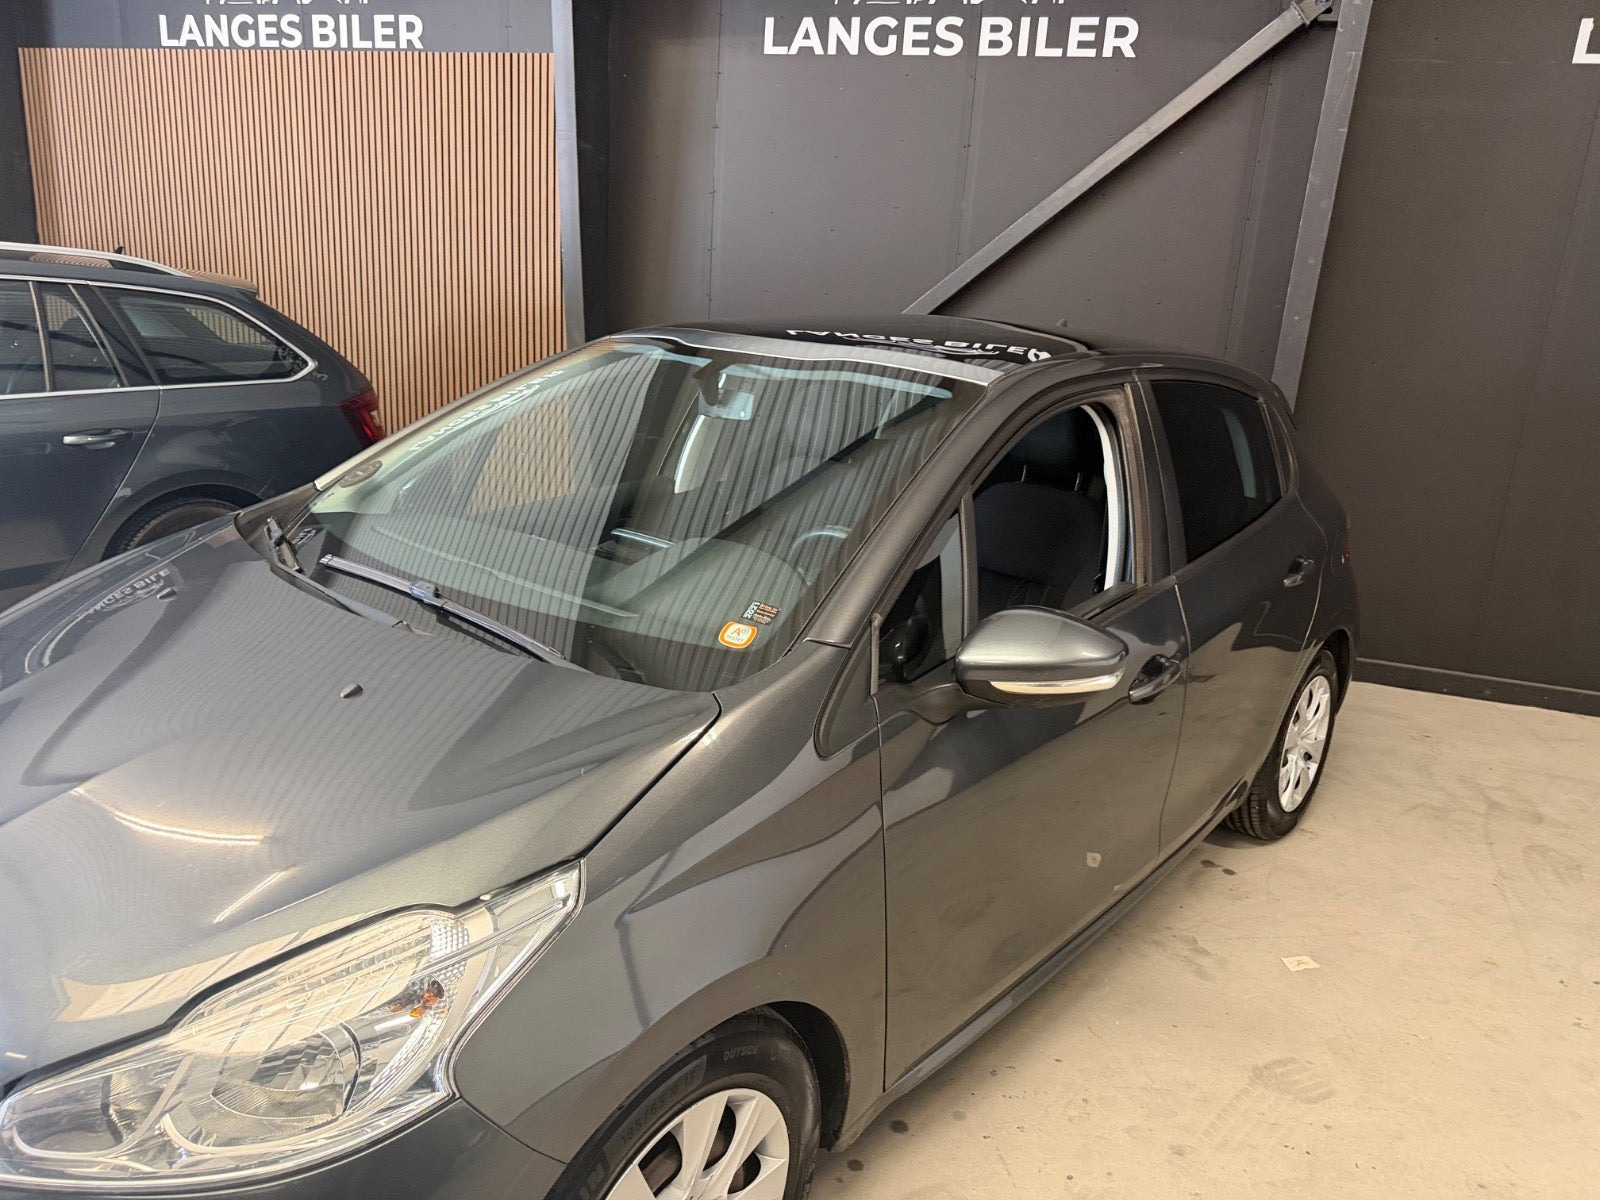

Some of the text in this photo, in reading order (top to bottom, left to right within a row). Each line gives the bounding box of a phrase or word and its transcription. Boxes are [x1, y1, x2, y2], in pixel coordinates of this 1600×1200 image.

[158, 13, 424, 49] LANGES BILER
[763, 16, 1140, 59] LANGES BILER
[723, 1045, 759, 1061] OUTSIDE
